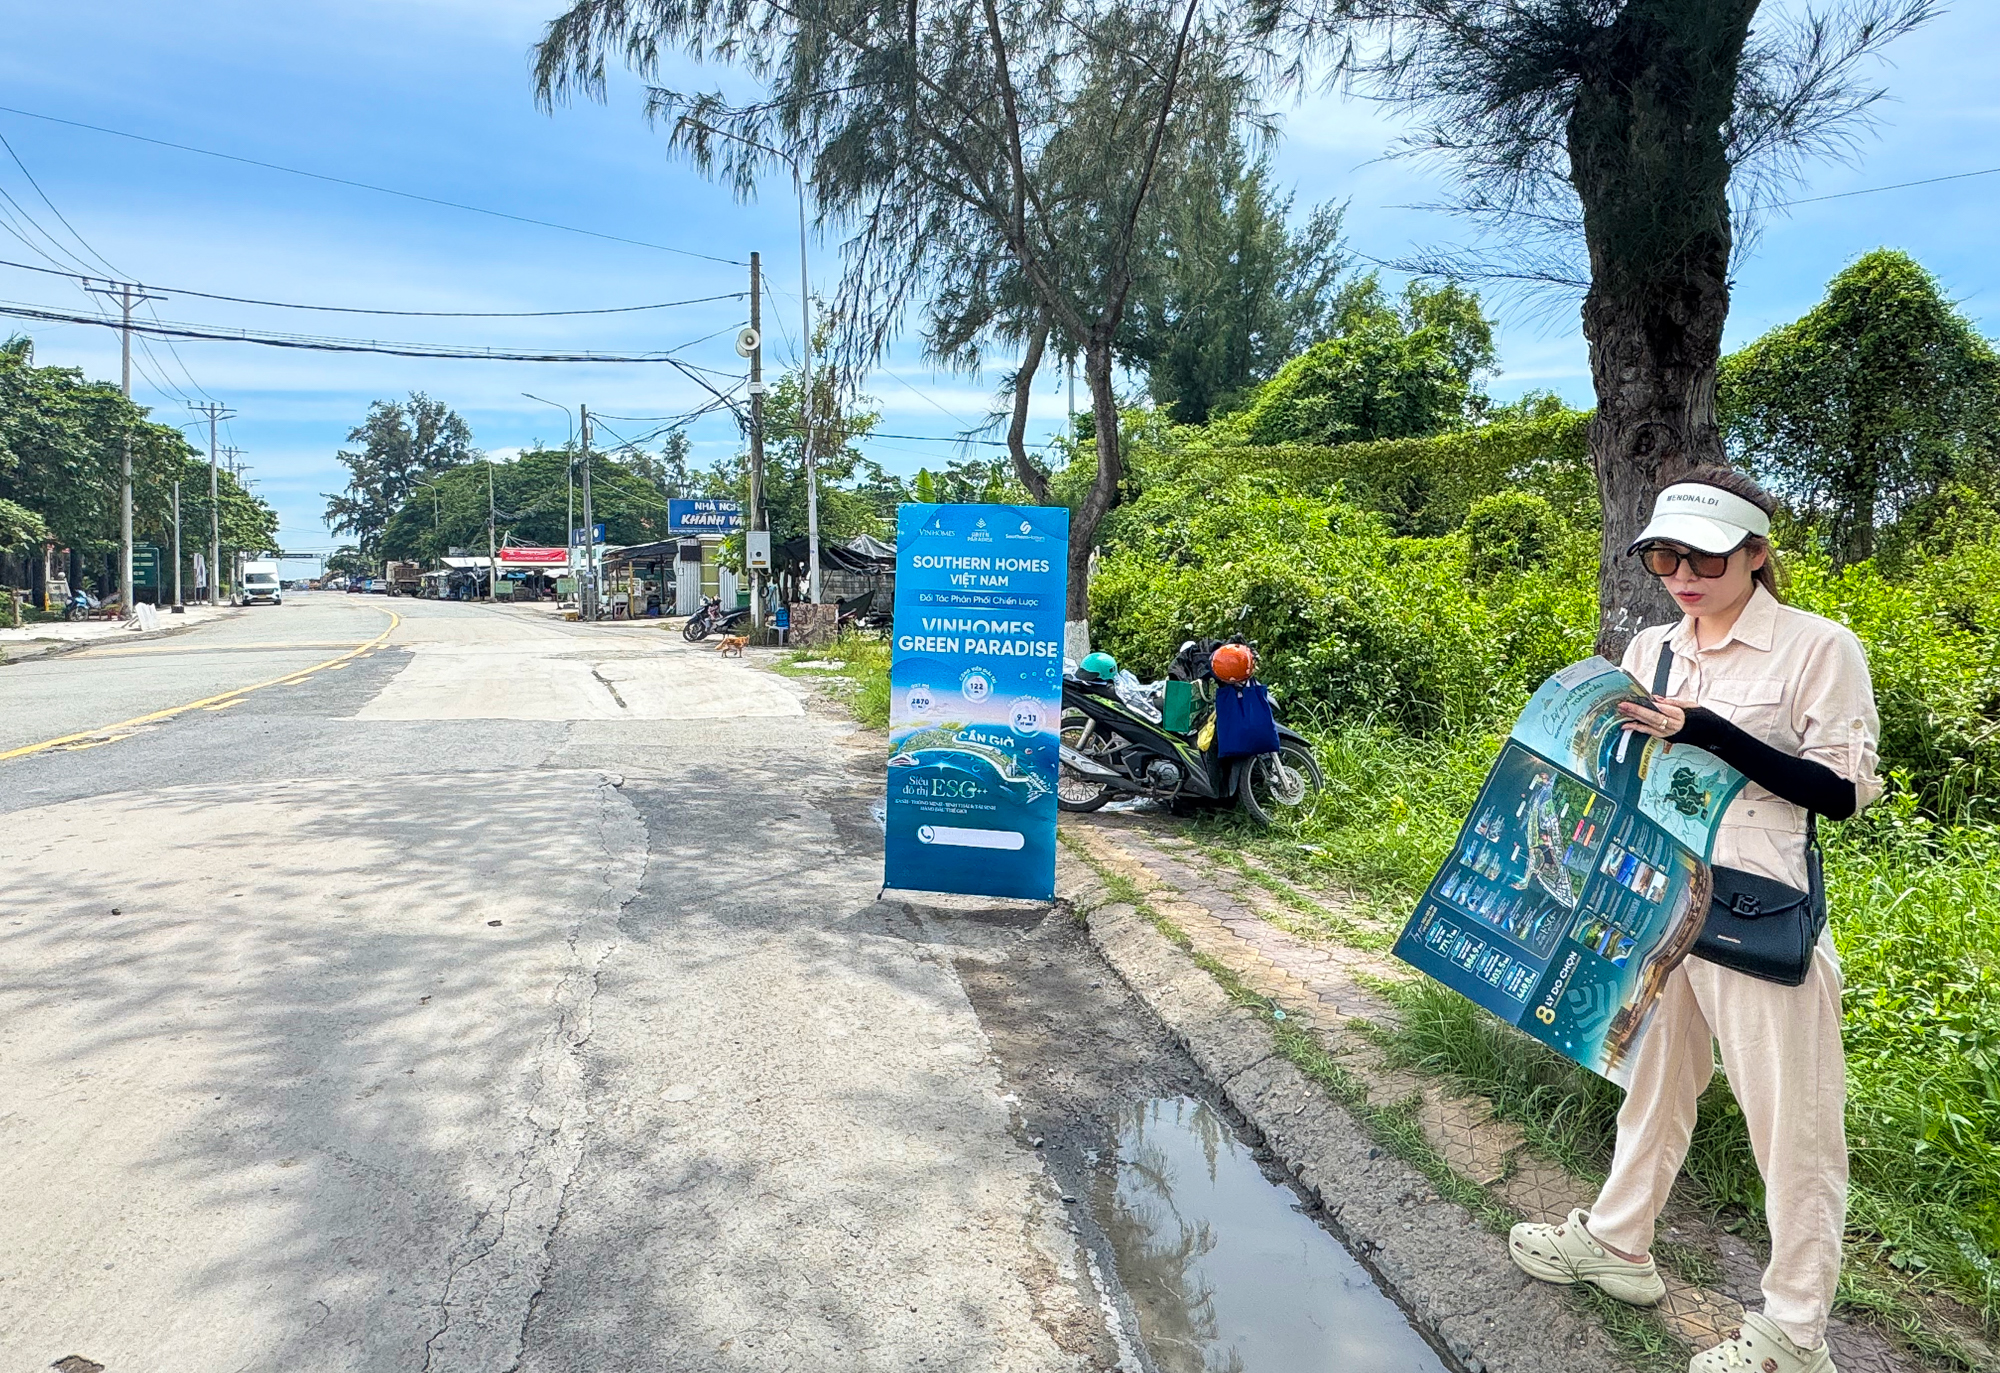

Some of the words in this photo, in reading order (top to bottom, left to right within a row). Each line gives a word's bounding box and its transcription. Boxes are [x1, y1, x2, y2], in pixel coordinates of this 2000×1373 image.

[695, 500, 716, 511] NHÀ
[681, 513, 725, 525] KHÁNH
[919, 528, 956, 538] VINHOMES
[913, 555, 990, 570] SOUTHERN
[995, 559, 1050, 573] HOMES
[950, 572, 976, 588] VIỆT
[980, 575, 1009, 587] NAM
[920, 593, 933, 602] Đối
[935, 594, 949, 603] Tác
[922, 618, 1035, 636] VINHOMES
[898, 635, 959, 653] GREEN
[965, 640, 1058, 658] PARADISE
[958, 729, 986, 743] CẦN
[988, 734, 1015, 748] GIỜ
[909, 775, 929, 786] Siêu
[902, 786, 914, 795] đô
[916, 787, 928, 797] thị
[1560, 951, 1579, 979] CHỌN
[1489, 963, 1506, 984] 303,5
[1550, 979, 1563, 995] DO
[1544, 994, 1555, 1007] LÝ
[1535, 1005, 1556, 1025] 8
